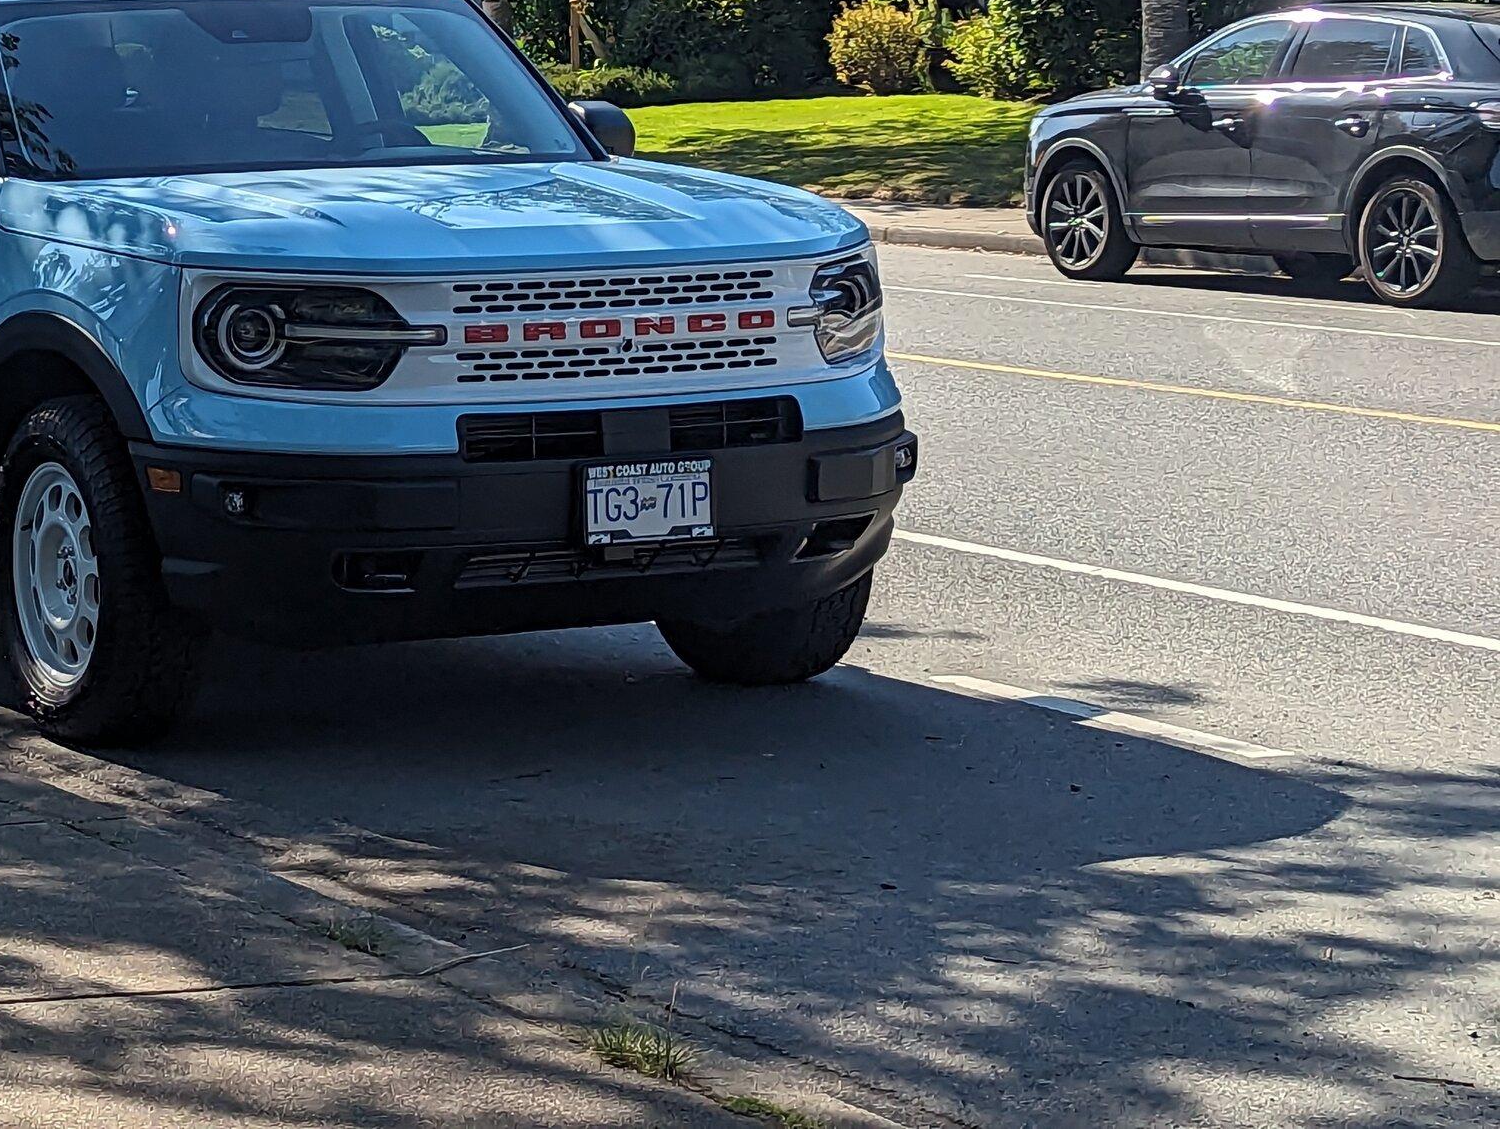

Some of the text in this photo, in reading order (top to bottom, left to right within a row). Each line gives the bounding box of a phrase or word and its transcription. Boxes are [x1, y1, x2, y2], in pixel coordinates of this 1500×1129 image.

[464, 309, 776, 344] BRONCO
[587, 460, 712, 479] WEST COAST AUTO GROUP
[587, 481, 709, 525] TG3 71P
